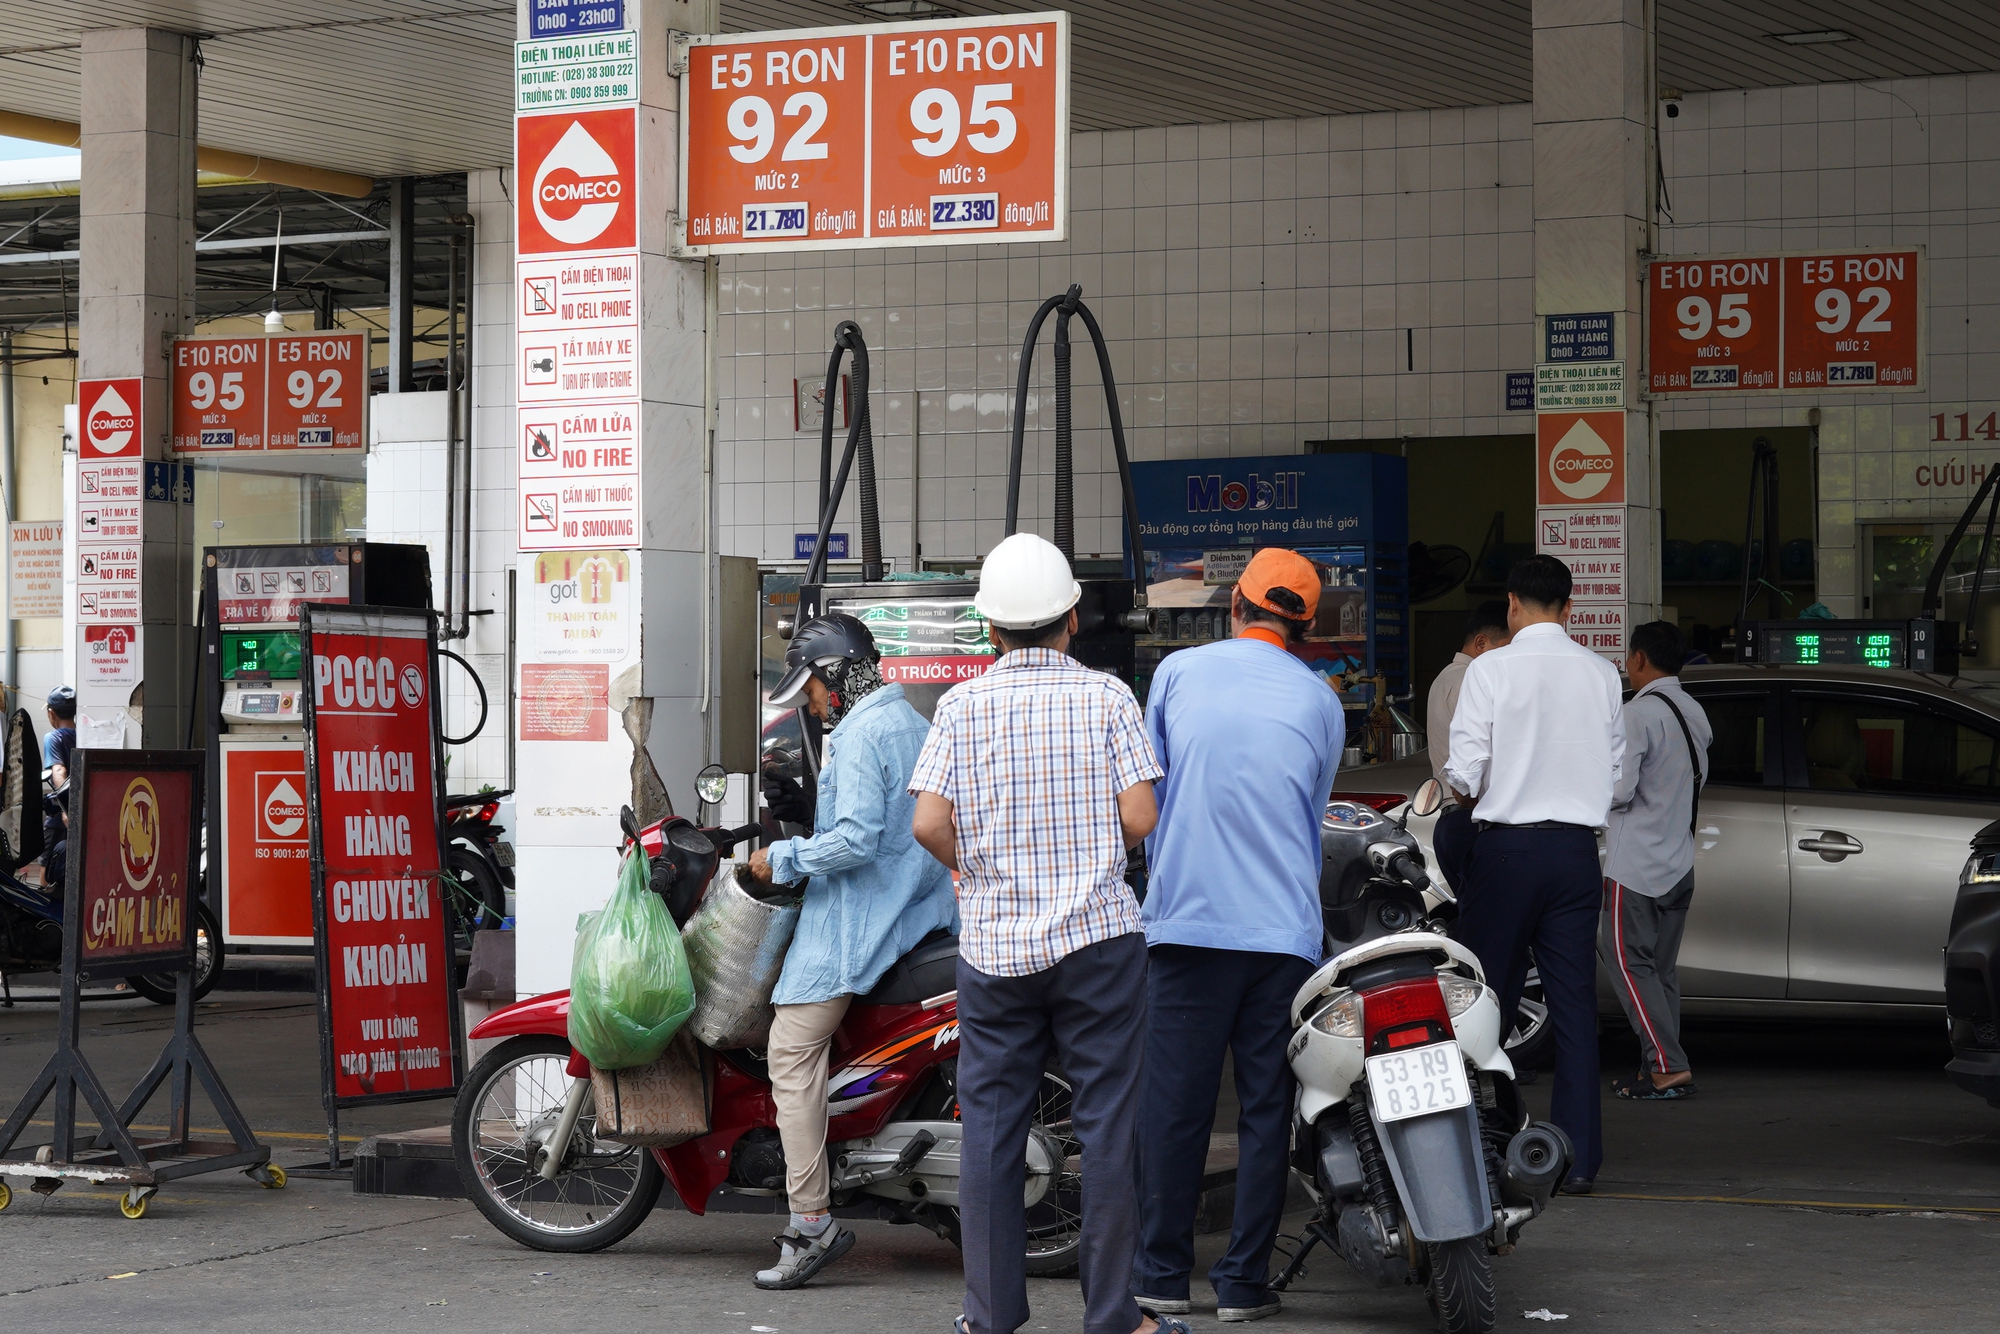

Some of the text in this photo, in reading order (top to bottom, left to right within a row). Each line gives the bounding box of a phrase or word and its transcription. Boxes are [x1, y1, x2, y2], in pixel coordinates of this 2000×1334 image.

[537, 13, 567, 30] 0h00
[579, 8, 616, 26] 23h00
[522, 38, 632, 65] ĐIỆN THOẠI LIÊN HỆ
[890, 32, 1043, 76] E10 RON
[522, 63, 633, 85] HOTLINE: (028) 38 300 222
[712, 46, 845, 89] E5 RON
[522, 84, 628, 104] TRƯỞNG CN: 0903 859 999
[727, 92, 829, 164] 92
[910, 83, 1017, 157] 95
[755, 171, 799, 191] MỨC 2
[939, 165, 986, 185] MỨC 3
[541, 180, 621, 202] COMECO
[693, 209, 857, 237] GIÁ BÁN: 21.780 đồng/lít
[878, 205, 897, 229] GIÁ
[902, 204, 926, 228] BÁN:
[933, 201, 995, 223] 22.330
[562, 265, 631, 286] CẤM ĐIỆN THOẠI
[1661, 263, 1769, 289] E10 RON
[1803, 258, 1904, 284] E5 RON
[562, 300, 631, 320] NO CELL PHONE
[1676, 293, 1752, 340] 95
[1814, 287, 1892, 334] 92
[1552, 319, 1607, 331] THỜI GIAN
[562, 336, 632, 357] TẮT MÁY XE
[1552, 331, 1608, 344] BÁN HÀNG
[1836, 339, 1870, 352] MỨC 2
[179, 344, 257, 366] E10 RON
[279, 341, 351, 363] E5 RON
[1552, 347, 1573, 358] 0h00
[1582, 345, 1609, 356] 23h00
[1698, 345, 1731, 358] MỨC 3
[562, 371, 632, 390] TURN OFF YOUR ENGINE
[1693, 369, 1737, 384] 22.330
[1829, 366, 1874, 381] 21.780
[189, 372, 245, 410] 95
[288, 369, 343, 408] 92
[92, 419, 134, 430] COMECO
[203, 412, 226, 424] MỨC 3
[302, 412, 326, 423] MỨC 2
[563, 412, 632, 434] CẤM LỬA
[1931, 412, 2000, 442] 114
[563, 448, 632, 468] NO FIRE
[1556, 458, 1614, 471] COMECO
[1916, 458, 1965, 486] CỨU
[563, 483, 633, 503] CẤM HÚT THUỐC
[1188, 472, 1298, 513] Mobil
[13, 525, 63, 542] XIN LƯU Ý
[563, 519, 633, 538] NO SMOKING
[1162, 524, 1189, 537] động
[1193, 524, 1207, 532] cơ
[1210, 519, 1233, 536] tổng
[1237, 521, 1259, 535] hợp
[1262, 520, 1289, 534] hàng
[1293, 516, 1313, 530] đầu
[1316, 515, 1333, 529] thế
[1338, 517, 1358, 531] giới
[101, 549, 137, 561] CẤM LỬA
[100, 569, 137, 580] NO FIRE
[551, 580, 603, 604] got it
[100, 608, 137, 619] NO SMOKING
[226, 604, 243, 618] TRẢ
[246, 603, 259, 617] VỀ
[547, 609, 617, 622] THANH TOÁN
[808, 603, 814, 618] 4
[563, 626, 603, 641] TẠI ĐÂY
[1747, 631, 1753, 641] 9
[1914, 631, 1925, 641] 10
[93, 640, 121, 654] got it
[901, 662, 952, 678] TRƯỚC
[957, 666, 982, 678] KHI
[313, 654, 396, 709] PCCC
[333, 745, 414, 792] KHÁCH
[269, 808, 305, 816] COMECO
[345, 809, 412, 857] HÀNG
[256, 848, 309, 858] ISO 9001:201
[333, 865, 430, 922] CHUYỂN
[343, 934, 427, 988] KHOẢN
[361, 1014, 418, 1041] VUI LÒNG
[341, 1046, 440, 1075] VÀO VĂN PHÒNG
[1381, 1049, 1449, 1084] 53-R9
[1388, 1078, 1456, 1115] 8325
